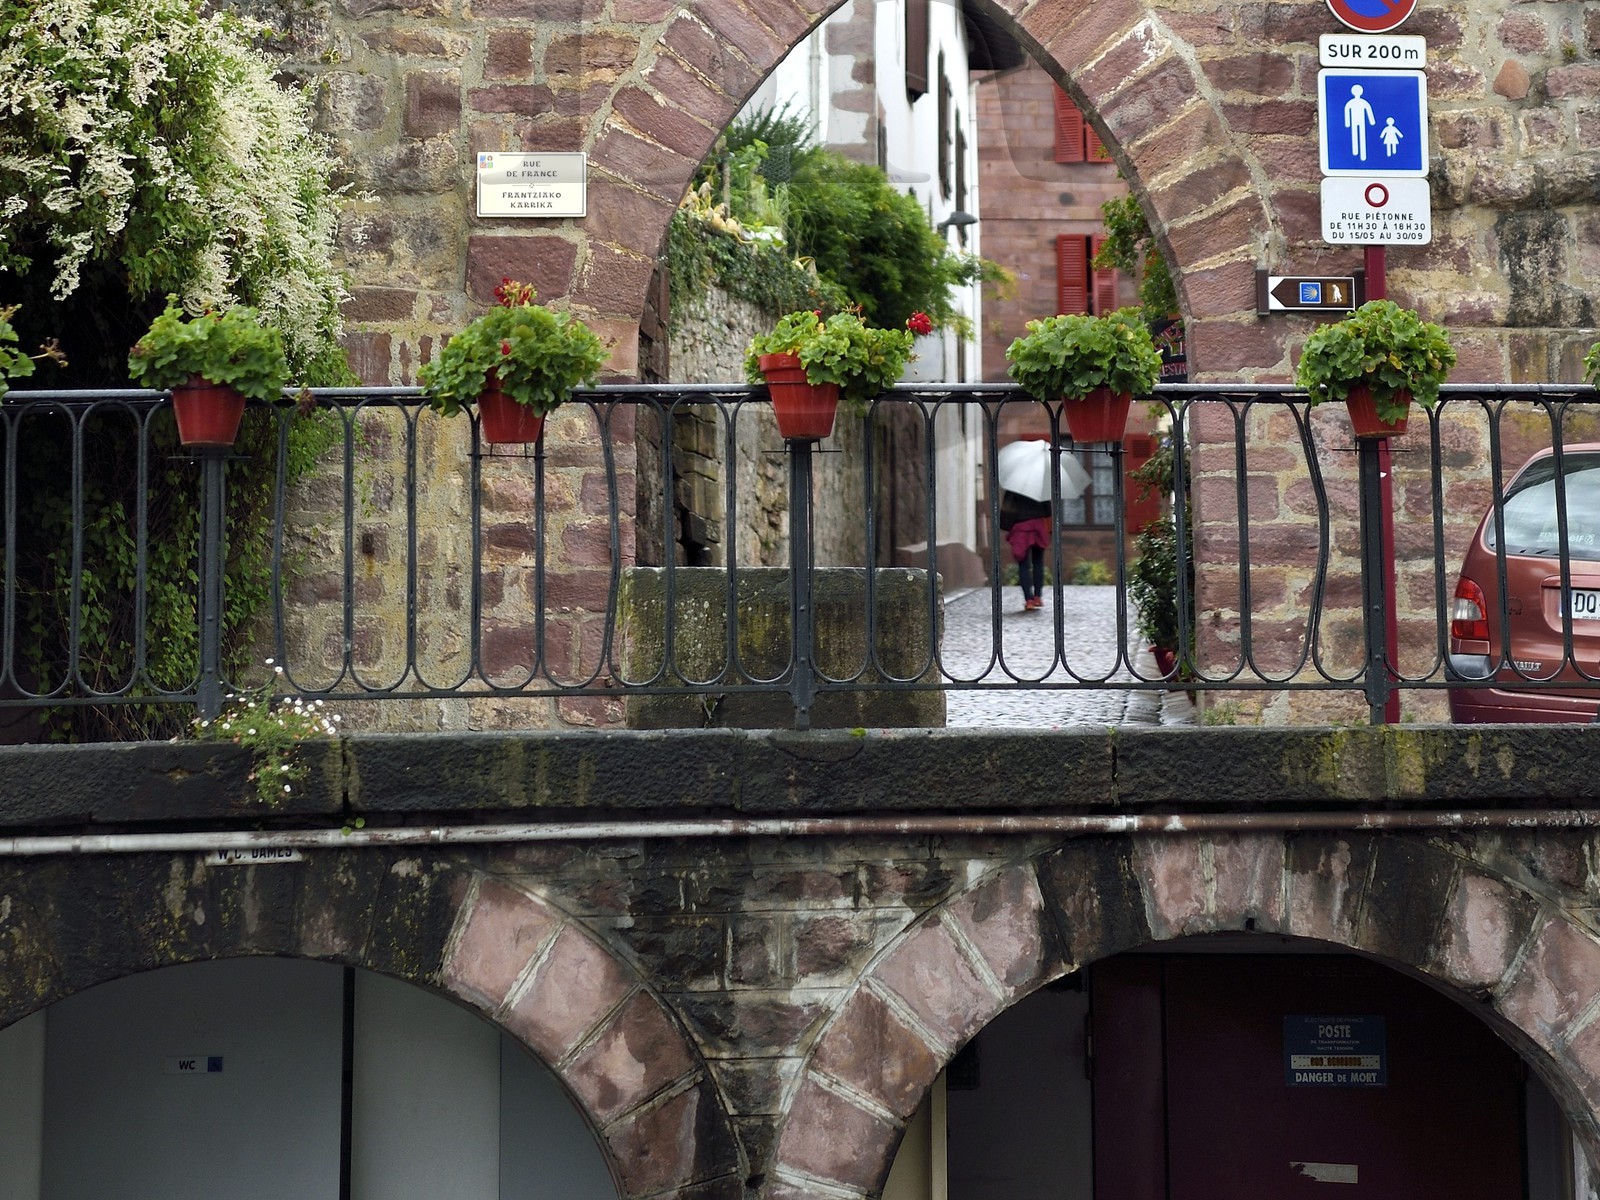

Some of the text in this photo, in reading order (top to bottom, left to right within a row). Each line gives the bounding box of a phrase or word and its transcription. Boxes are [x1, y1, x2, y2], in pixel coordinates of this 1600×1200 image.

[1328, 44, 1361, 58] SUR
[1341, 211, 1413, 220] RUE PIÉTONNE
[1330, 222, 1342, 230] DE
[1383, 221, 1388, 230] À
[1396, 232, 1423, 240] 30/09
[1318, 1025, 1351, 1038] POSTE
[179, 1060, 196, 1070] WC
[1295, 1072, 1377, 1083] DANGER DE MORT
